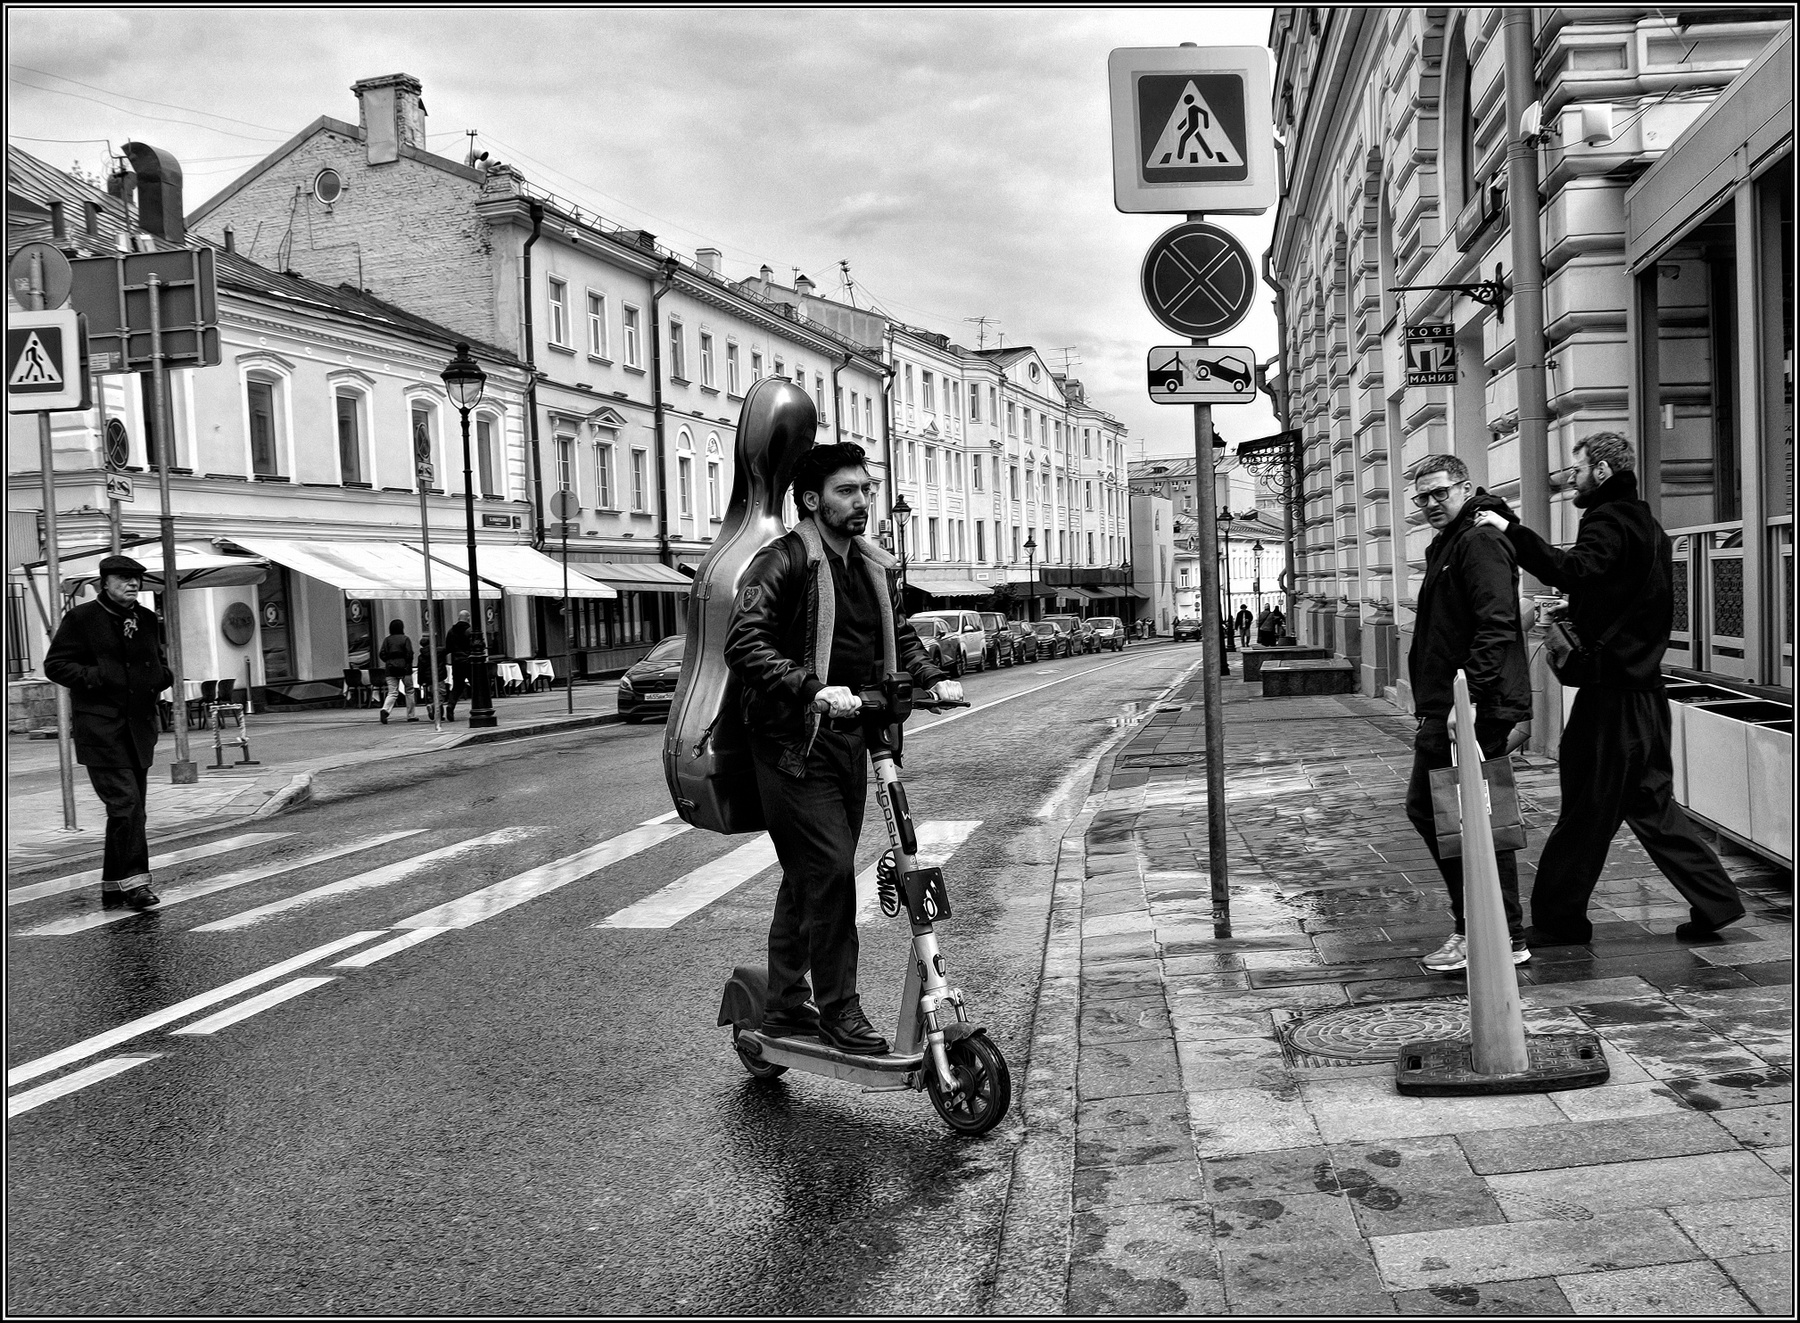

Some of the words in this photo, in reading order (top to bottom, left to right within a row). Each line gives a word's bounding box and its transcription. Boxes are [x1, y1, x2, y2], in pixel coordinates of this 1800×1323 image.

[1408, 327, 1452, 337] КОФЕ
[1410, 374, 1454, 383] МАНИЯ
[875, 766, 899, 847] WHOOSH
